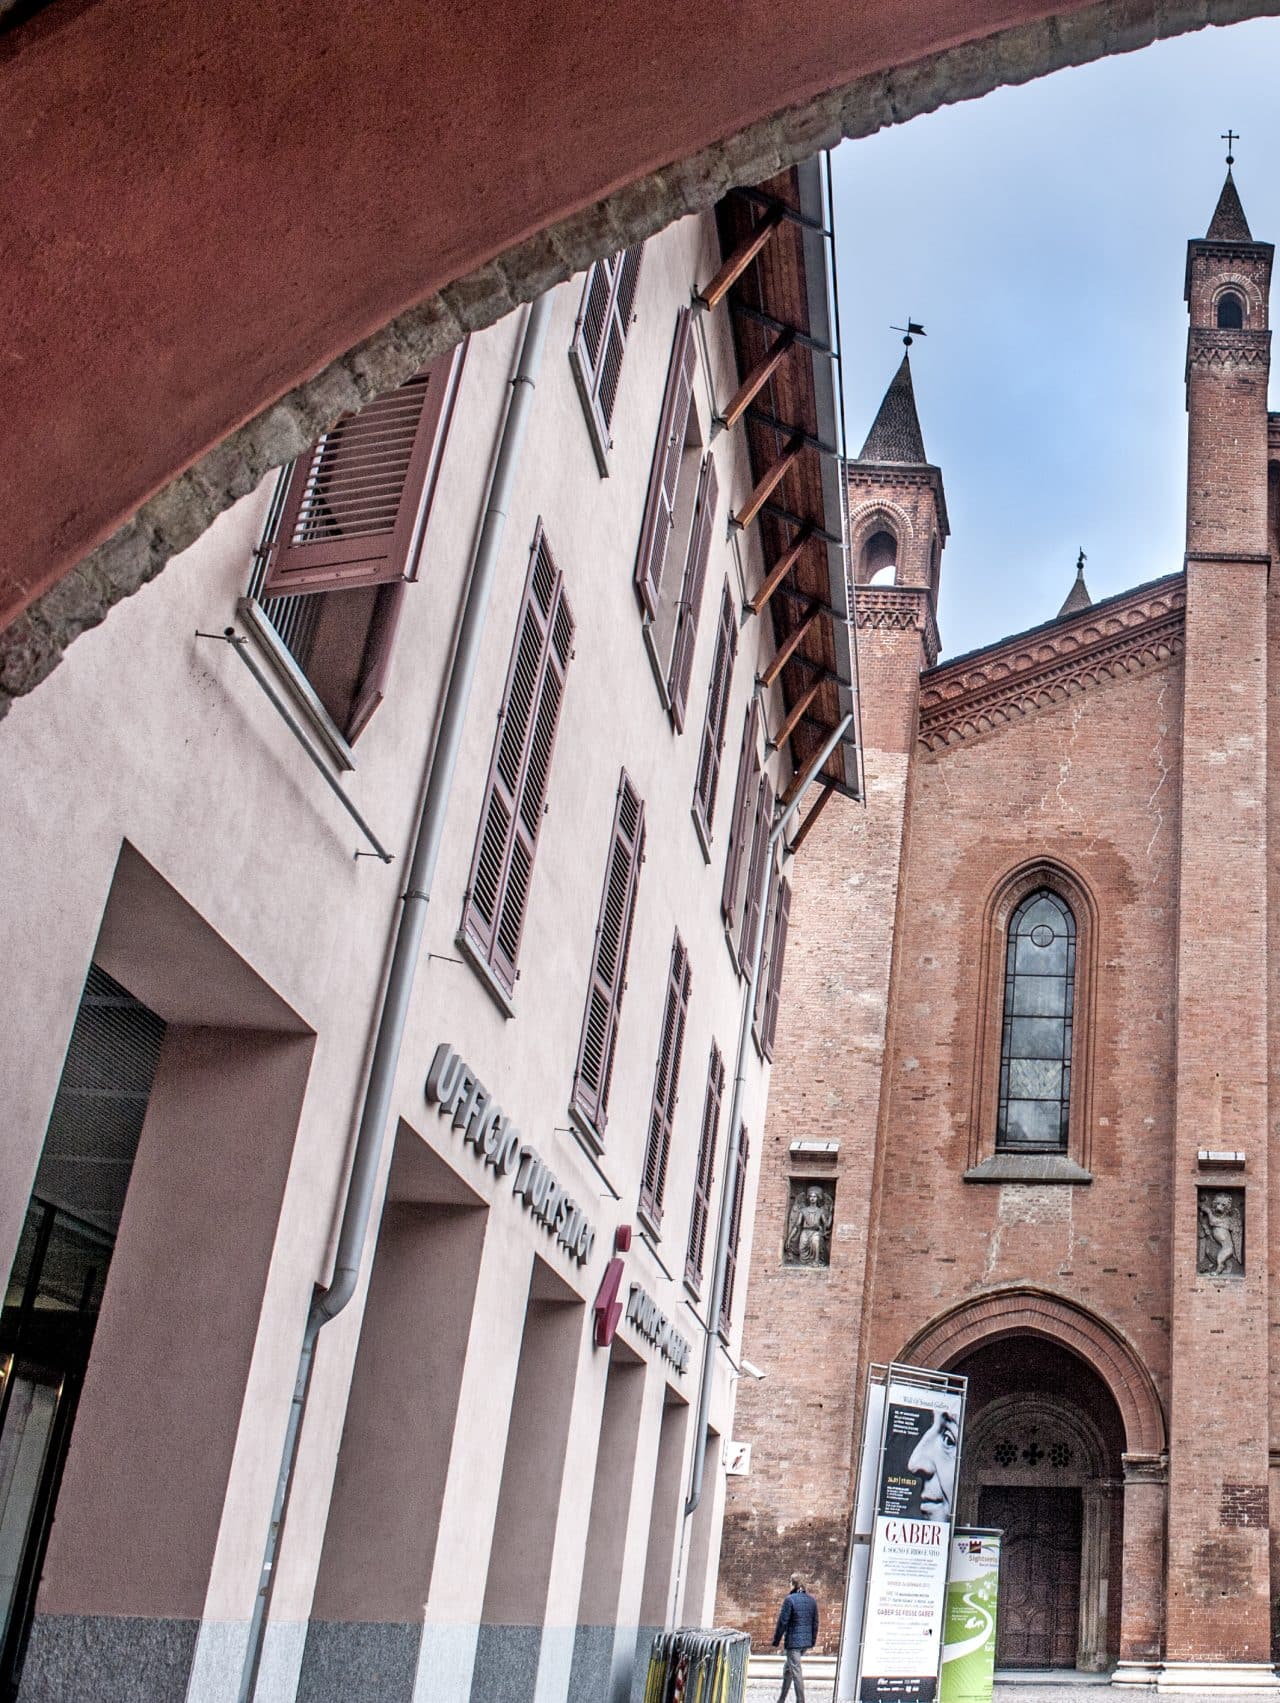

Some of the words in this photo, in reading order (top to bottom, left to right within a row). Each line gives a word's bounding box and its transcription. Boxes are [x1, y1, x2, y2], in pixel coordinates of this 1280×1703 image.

[425, 1043, 520, 1175] UFFICIO
[513, 1145, 595, 1265] TURISTICO
[885, 1520, 942, 1546] GABER
[877, 1608, 894, 1616] GABER
[918, 1610, 934, 1618] GABER
